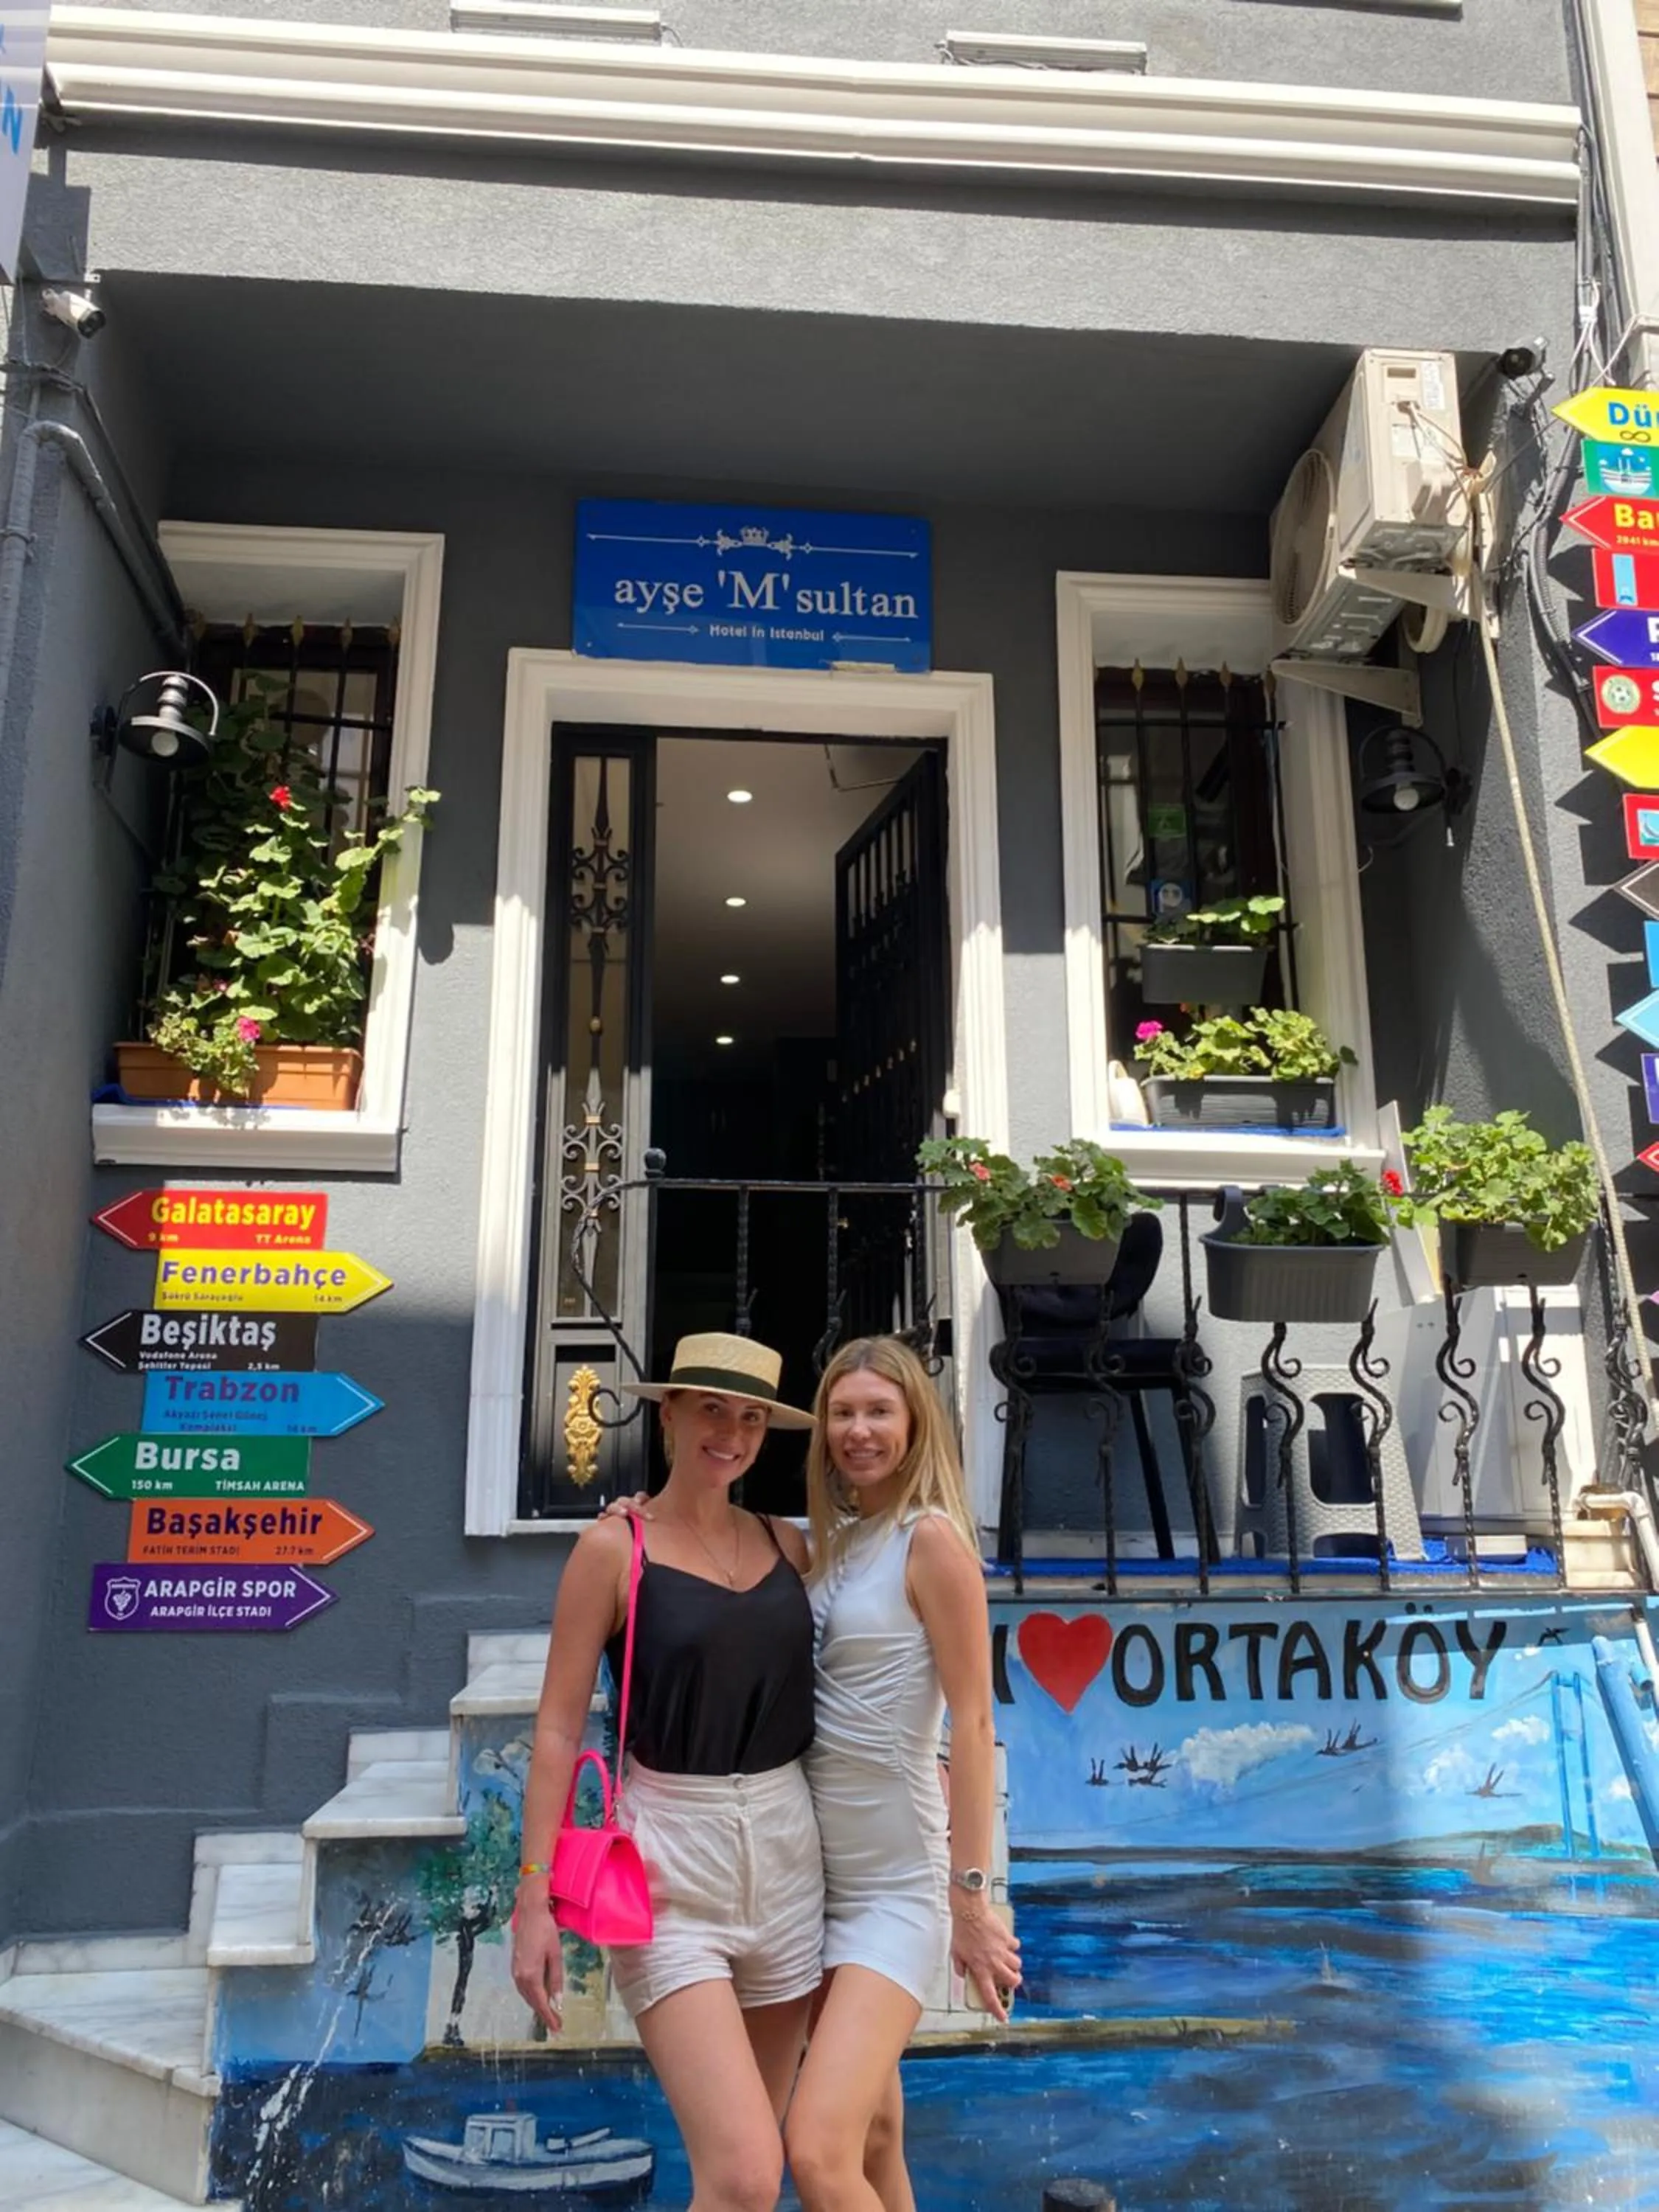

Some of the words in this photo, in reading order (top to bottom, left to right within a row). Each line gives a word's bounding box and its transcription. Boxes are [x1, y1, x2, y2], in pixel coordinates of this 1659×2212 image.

[1608, 402, 1659, 428] Dü
[1614, 503, 1659, 530] Ba
[614, 579, 704, 614] ayşe
[717, 569, 790, 610] 'M'
[796, 581, 919, 618] sultan
[709, 624, 748, 637] Hotel
[151, 1196, 316, 1231] Galatasaray
[161, 1234, 179, 1243] km
[255, 1234, 272, 1244] TT
[274, 1234, 312, 1245] Arena
[161, 1261, 347, 1290] Fenerbahçe
[329, 1294, 342, 1304] km
[140, 1313, 276, 1352] Beşiktaş
[139, 1352, 186, 1360] Vodafone
[188, 1352, 218, 1360] Arena
[165, 1375, 300, 1402] Trabzon
[135, 1441, 240, 1470] Bursa
[131, 1479, 152, 1490] 150
[154, 1480, 173, 1490] km
[215, 1479, 260, 1491] TİMSAH
[262, 1480, 305, 1492] ARENA
[147, 1507, 322, 1540] Başakşehir
[298, 1546, 314, 1556] km
[144, 1577, 236, 1598] ARAPGİR
[241, 1581, 296, 1598] SPOR
[150, 1604, 204, 1617] ARAPGİR
[207, 1604, 233, 1618] İLÇE
[235, 1607, 272, 1617] STADI
[1111, 1602, 1507, 1707] ORTAKÖY
